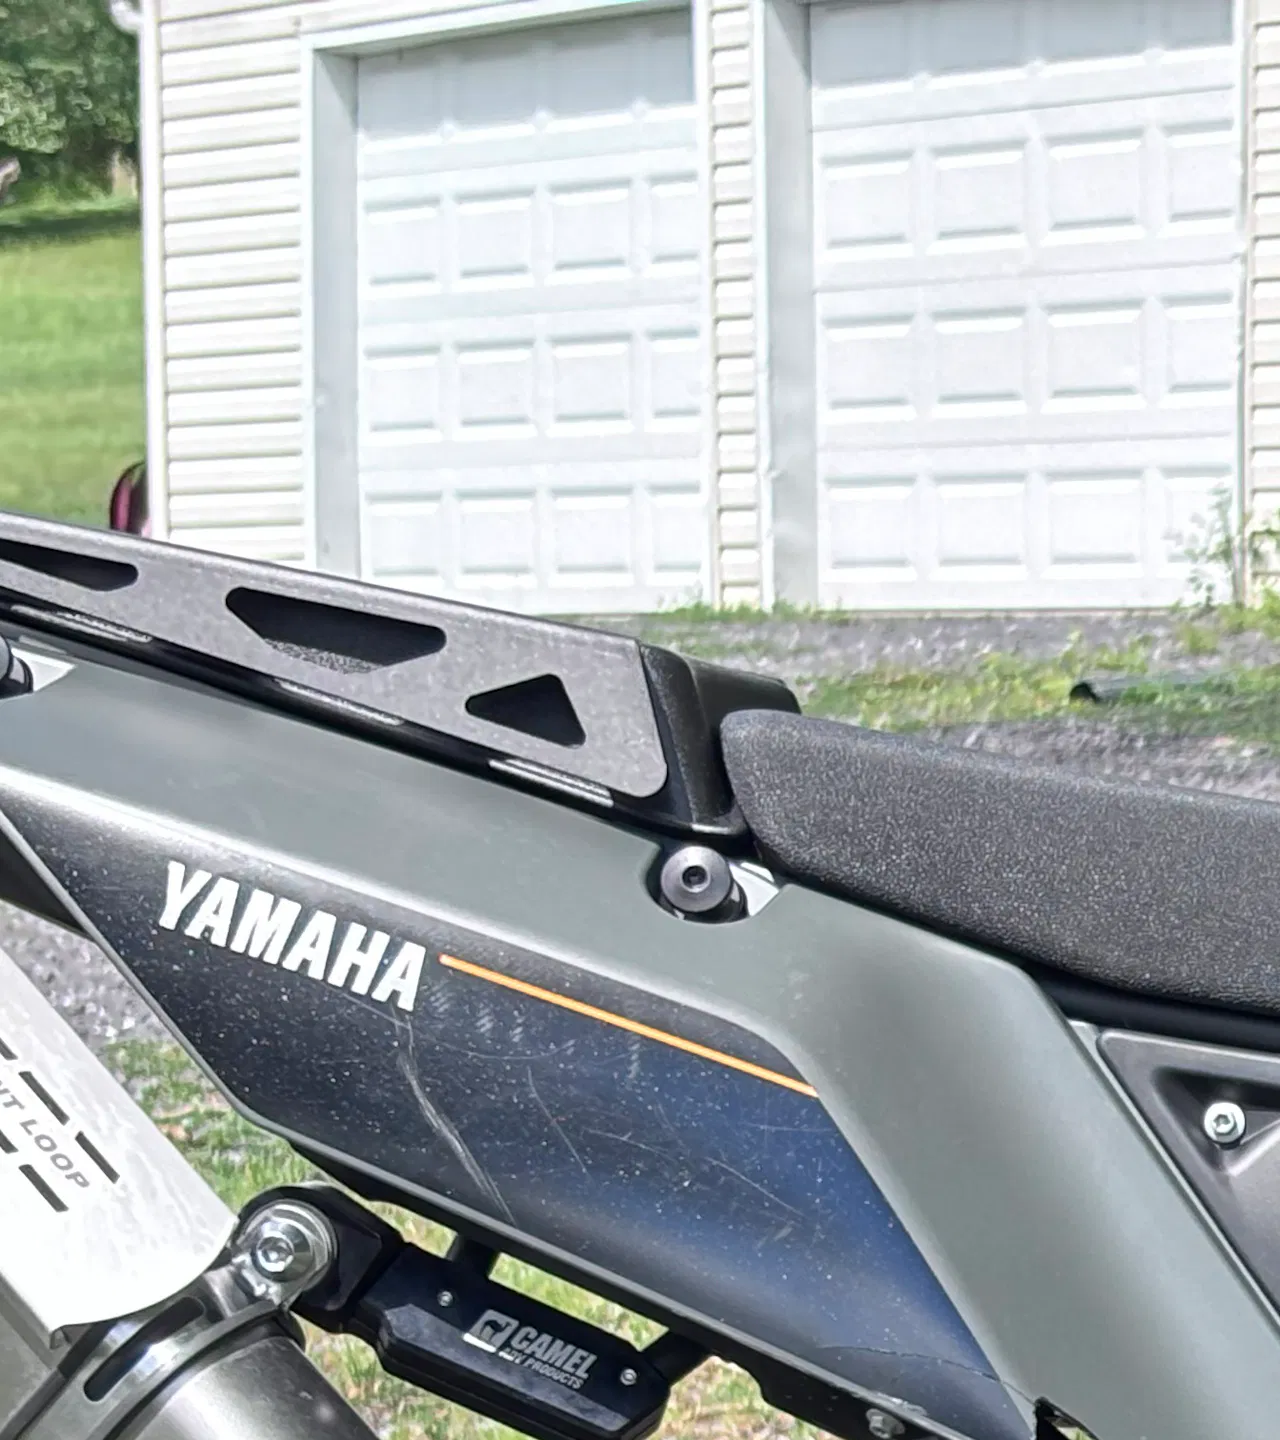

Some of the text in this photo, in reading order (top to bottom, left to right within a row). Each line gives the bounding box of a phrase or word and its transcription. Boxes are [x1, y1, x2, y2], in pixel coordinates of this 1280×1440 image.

[158, 860, 427, 1012] YAMAHA
[19, 1118, 91, 1188] LOOP
[511, 1326, 598, 1380] CAMEL
[522, 1358, 584, 1390] PRODUCTS
